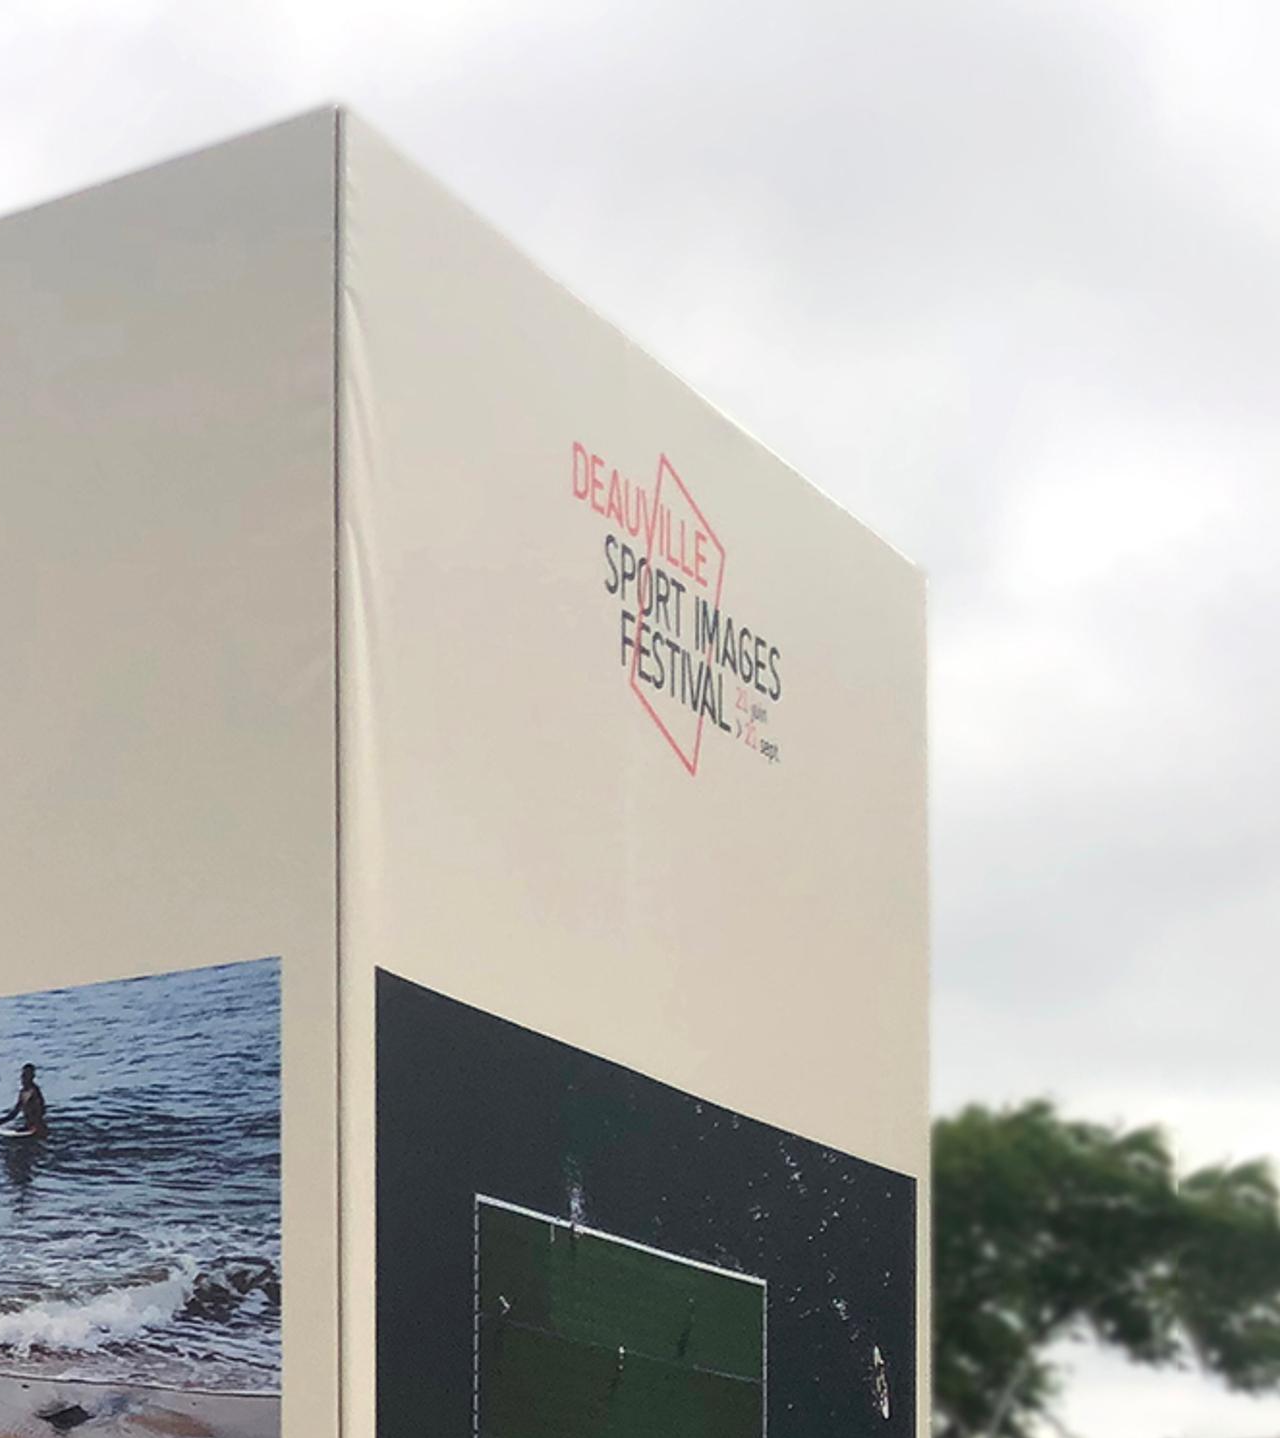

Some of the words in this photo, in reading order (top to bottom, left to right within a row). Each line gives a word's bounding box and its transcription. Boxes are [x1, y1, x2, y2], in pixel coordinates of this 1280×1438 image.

[572, 441, 709, 588] DEAUVILLE
[604, 534, 687, 638] SPORT
[695, 597, 781, 701] IMAGES
[620, 610, 732, 732] FESTIVAL
